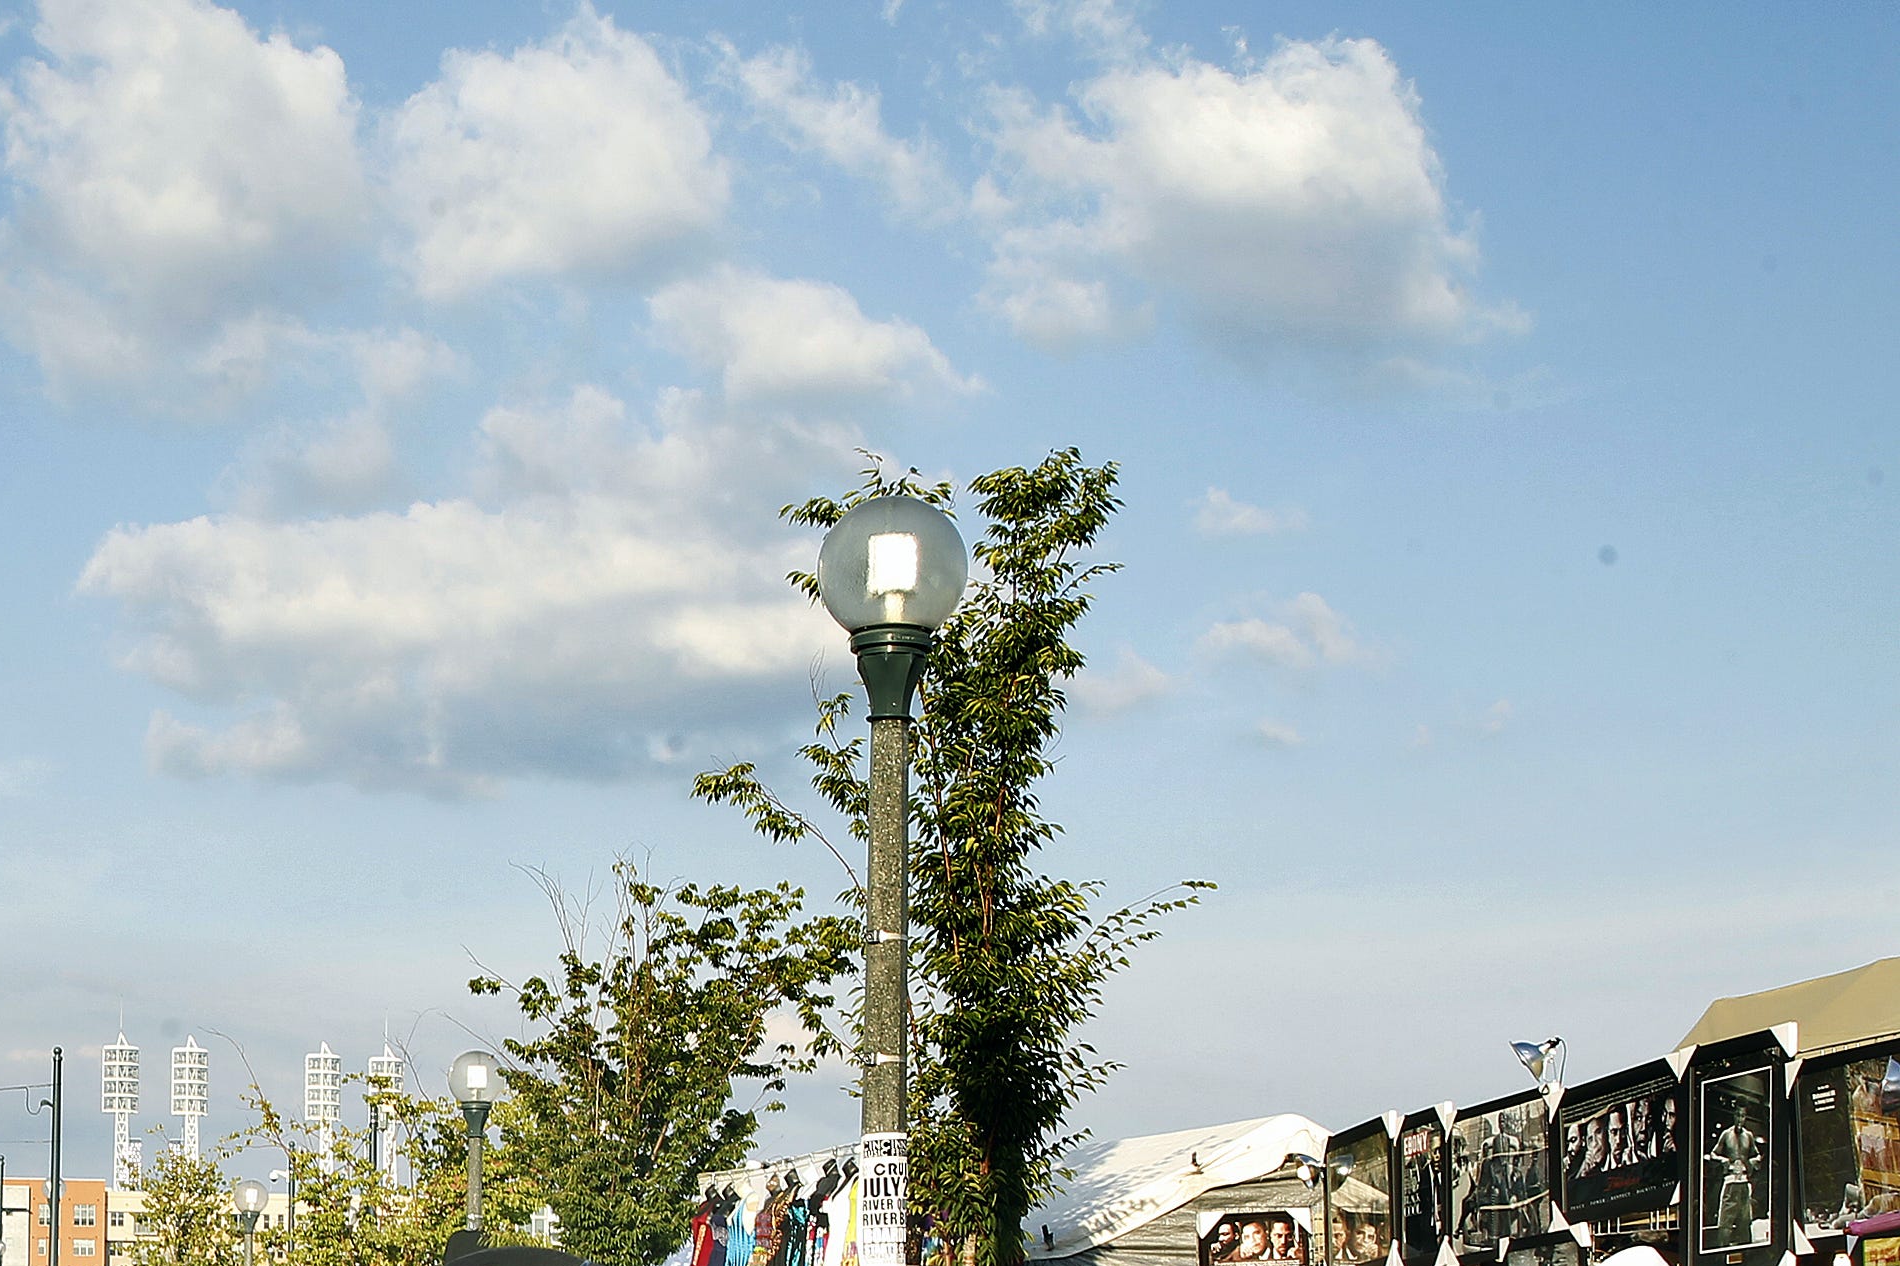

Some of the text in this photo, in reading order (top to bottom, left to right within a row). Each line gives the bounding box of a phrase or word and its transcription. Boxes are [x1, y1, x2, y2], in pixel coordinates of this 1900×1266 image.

[1403, 1131, 1429, 1157] EBONY
[863, 1176, 900, 1198] JULY
[863, 1198, 893, 1211] RIVER
